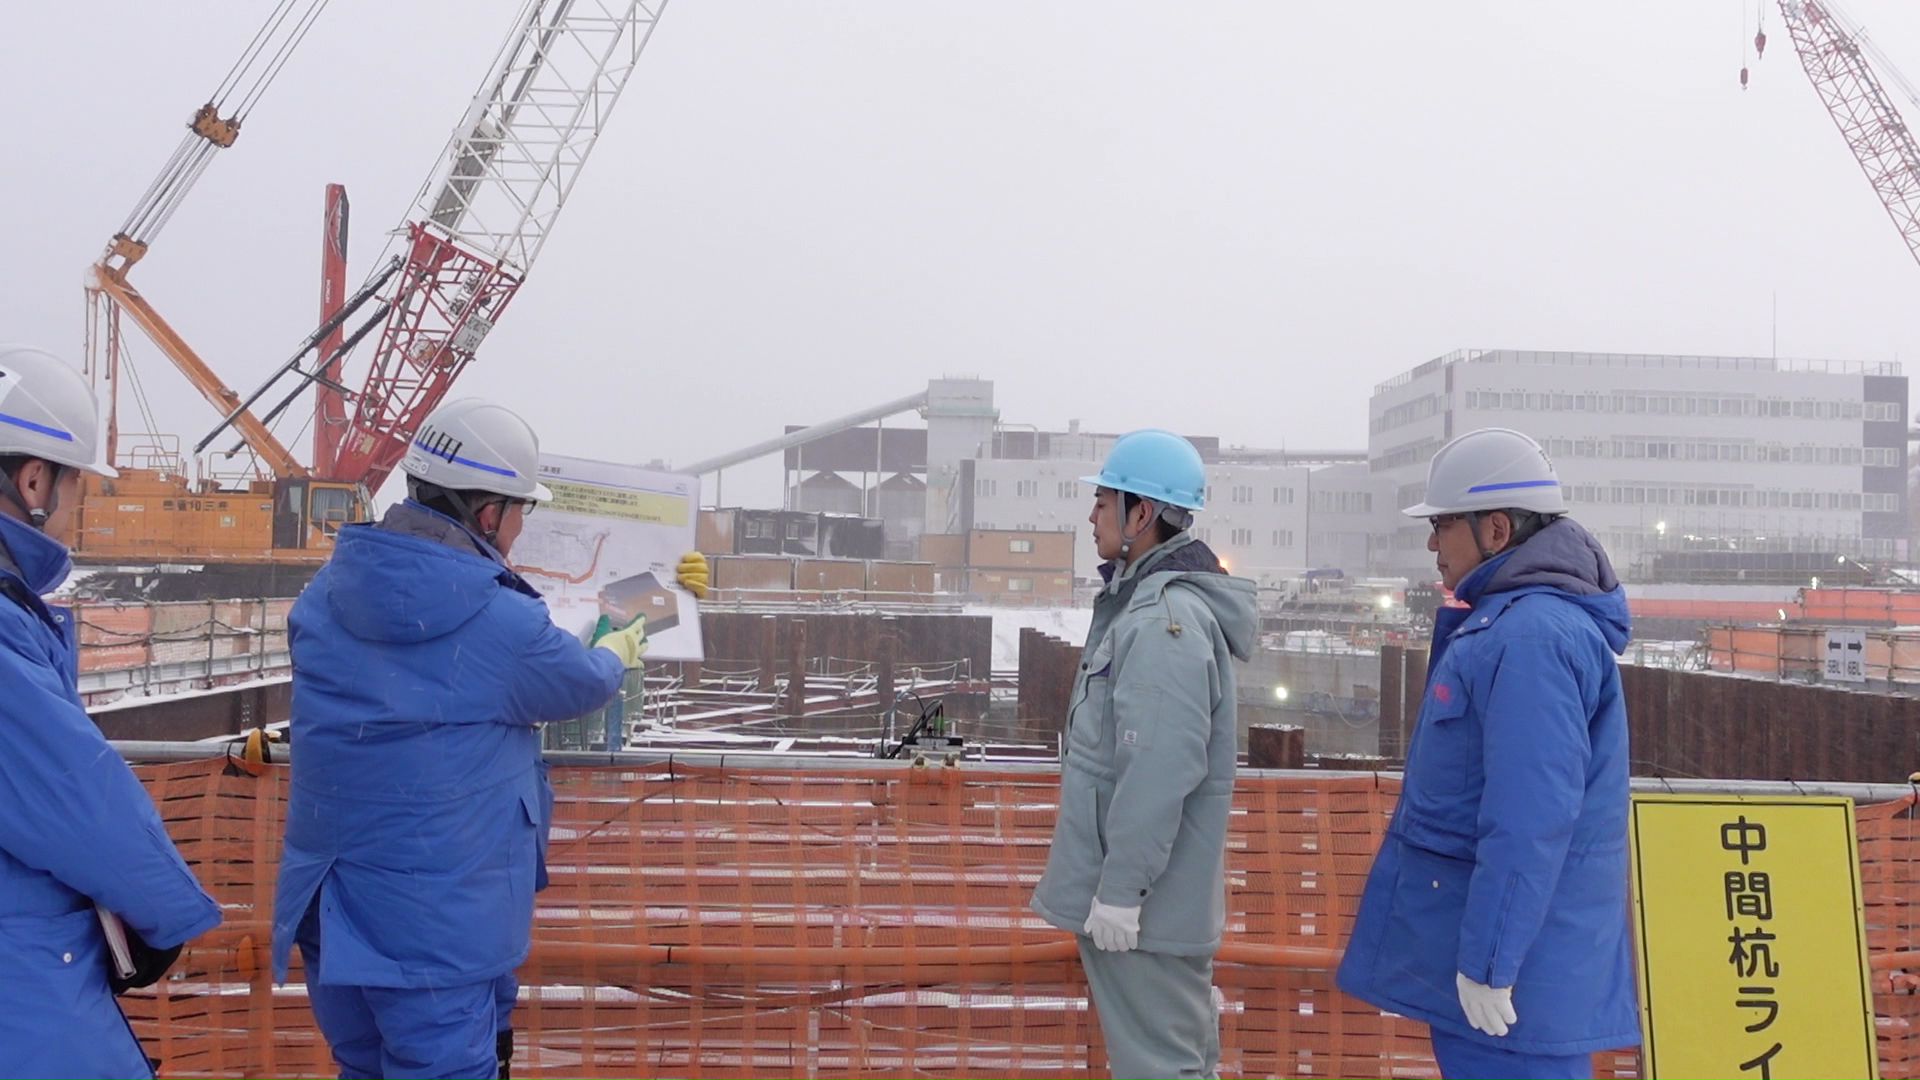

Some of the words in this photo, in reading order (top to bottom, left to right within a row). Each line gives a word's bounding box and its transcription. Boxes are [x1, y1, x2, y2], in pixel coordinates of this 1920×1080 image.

[1721, 815, 1783, 1080] 中間杭ライ
